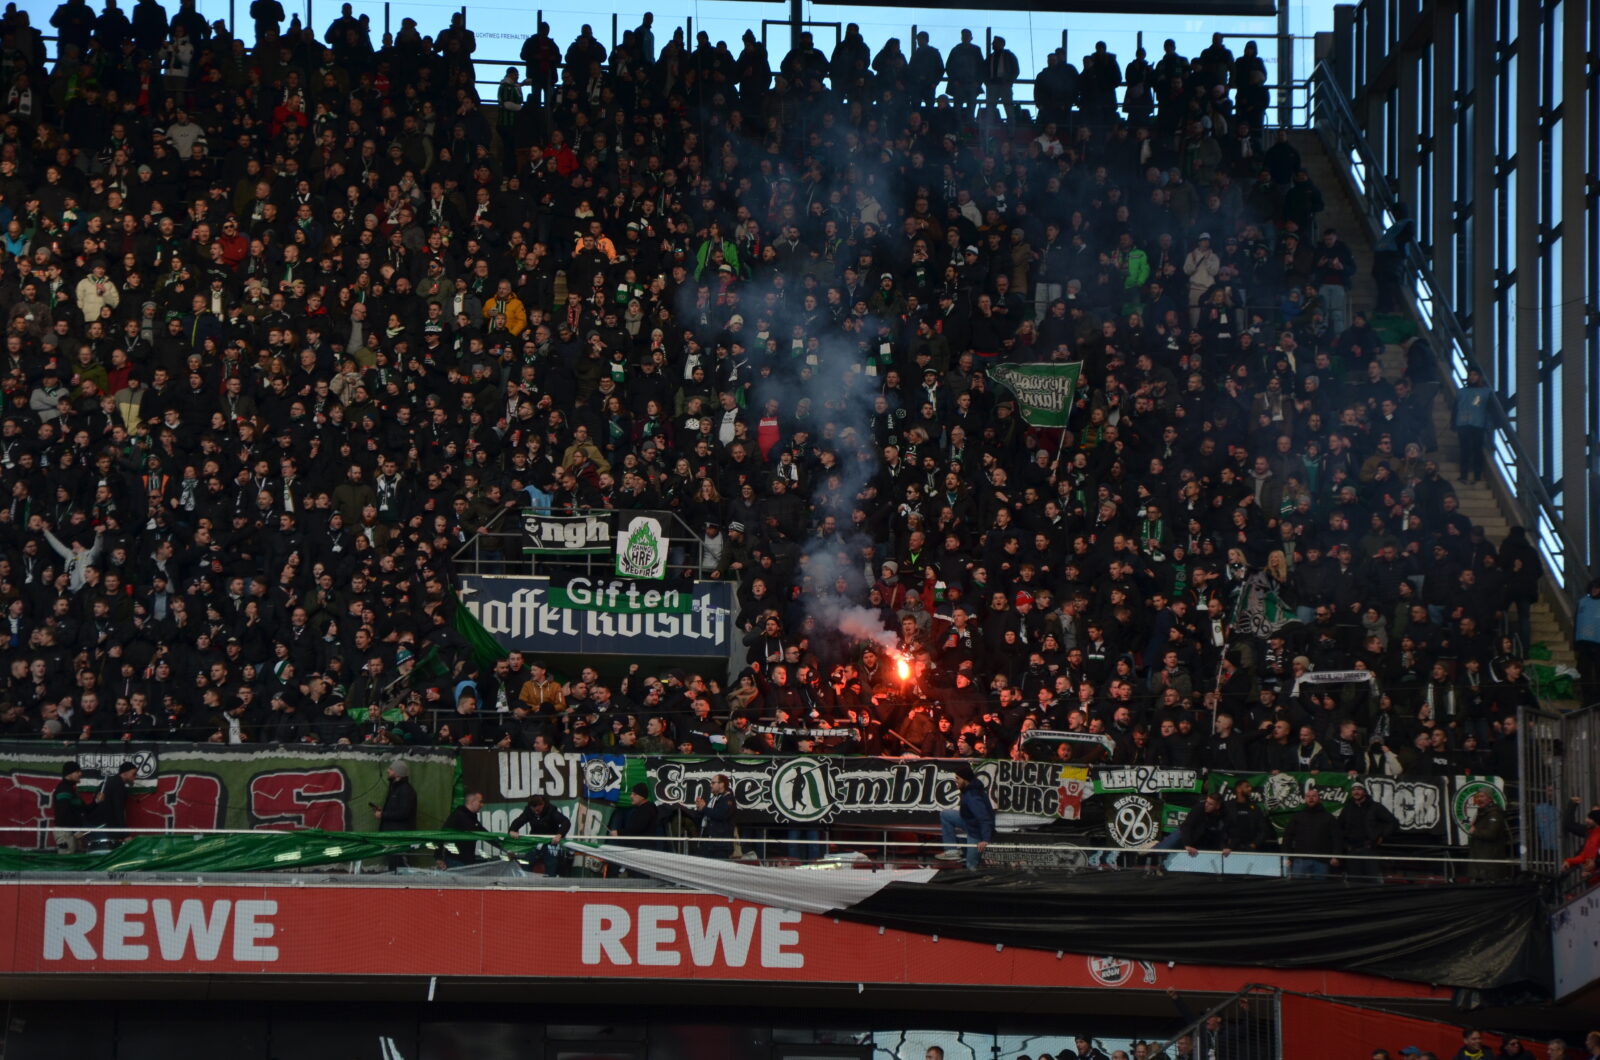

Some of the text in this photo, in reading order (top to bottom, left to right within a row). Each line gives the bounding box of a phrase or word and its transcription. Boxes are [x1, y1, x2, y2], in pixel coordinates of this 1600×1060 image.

[541, 517, 611, 548] ngh
[566, 577, 680, 609] Giften
[499, 752, 582, 799] WEST
[1113, 794, 1155, 812] SEKTION
[43, 898, 279, 961] REWE
[581, 904, 804, 968] REWE
